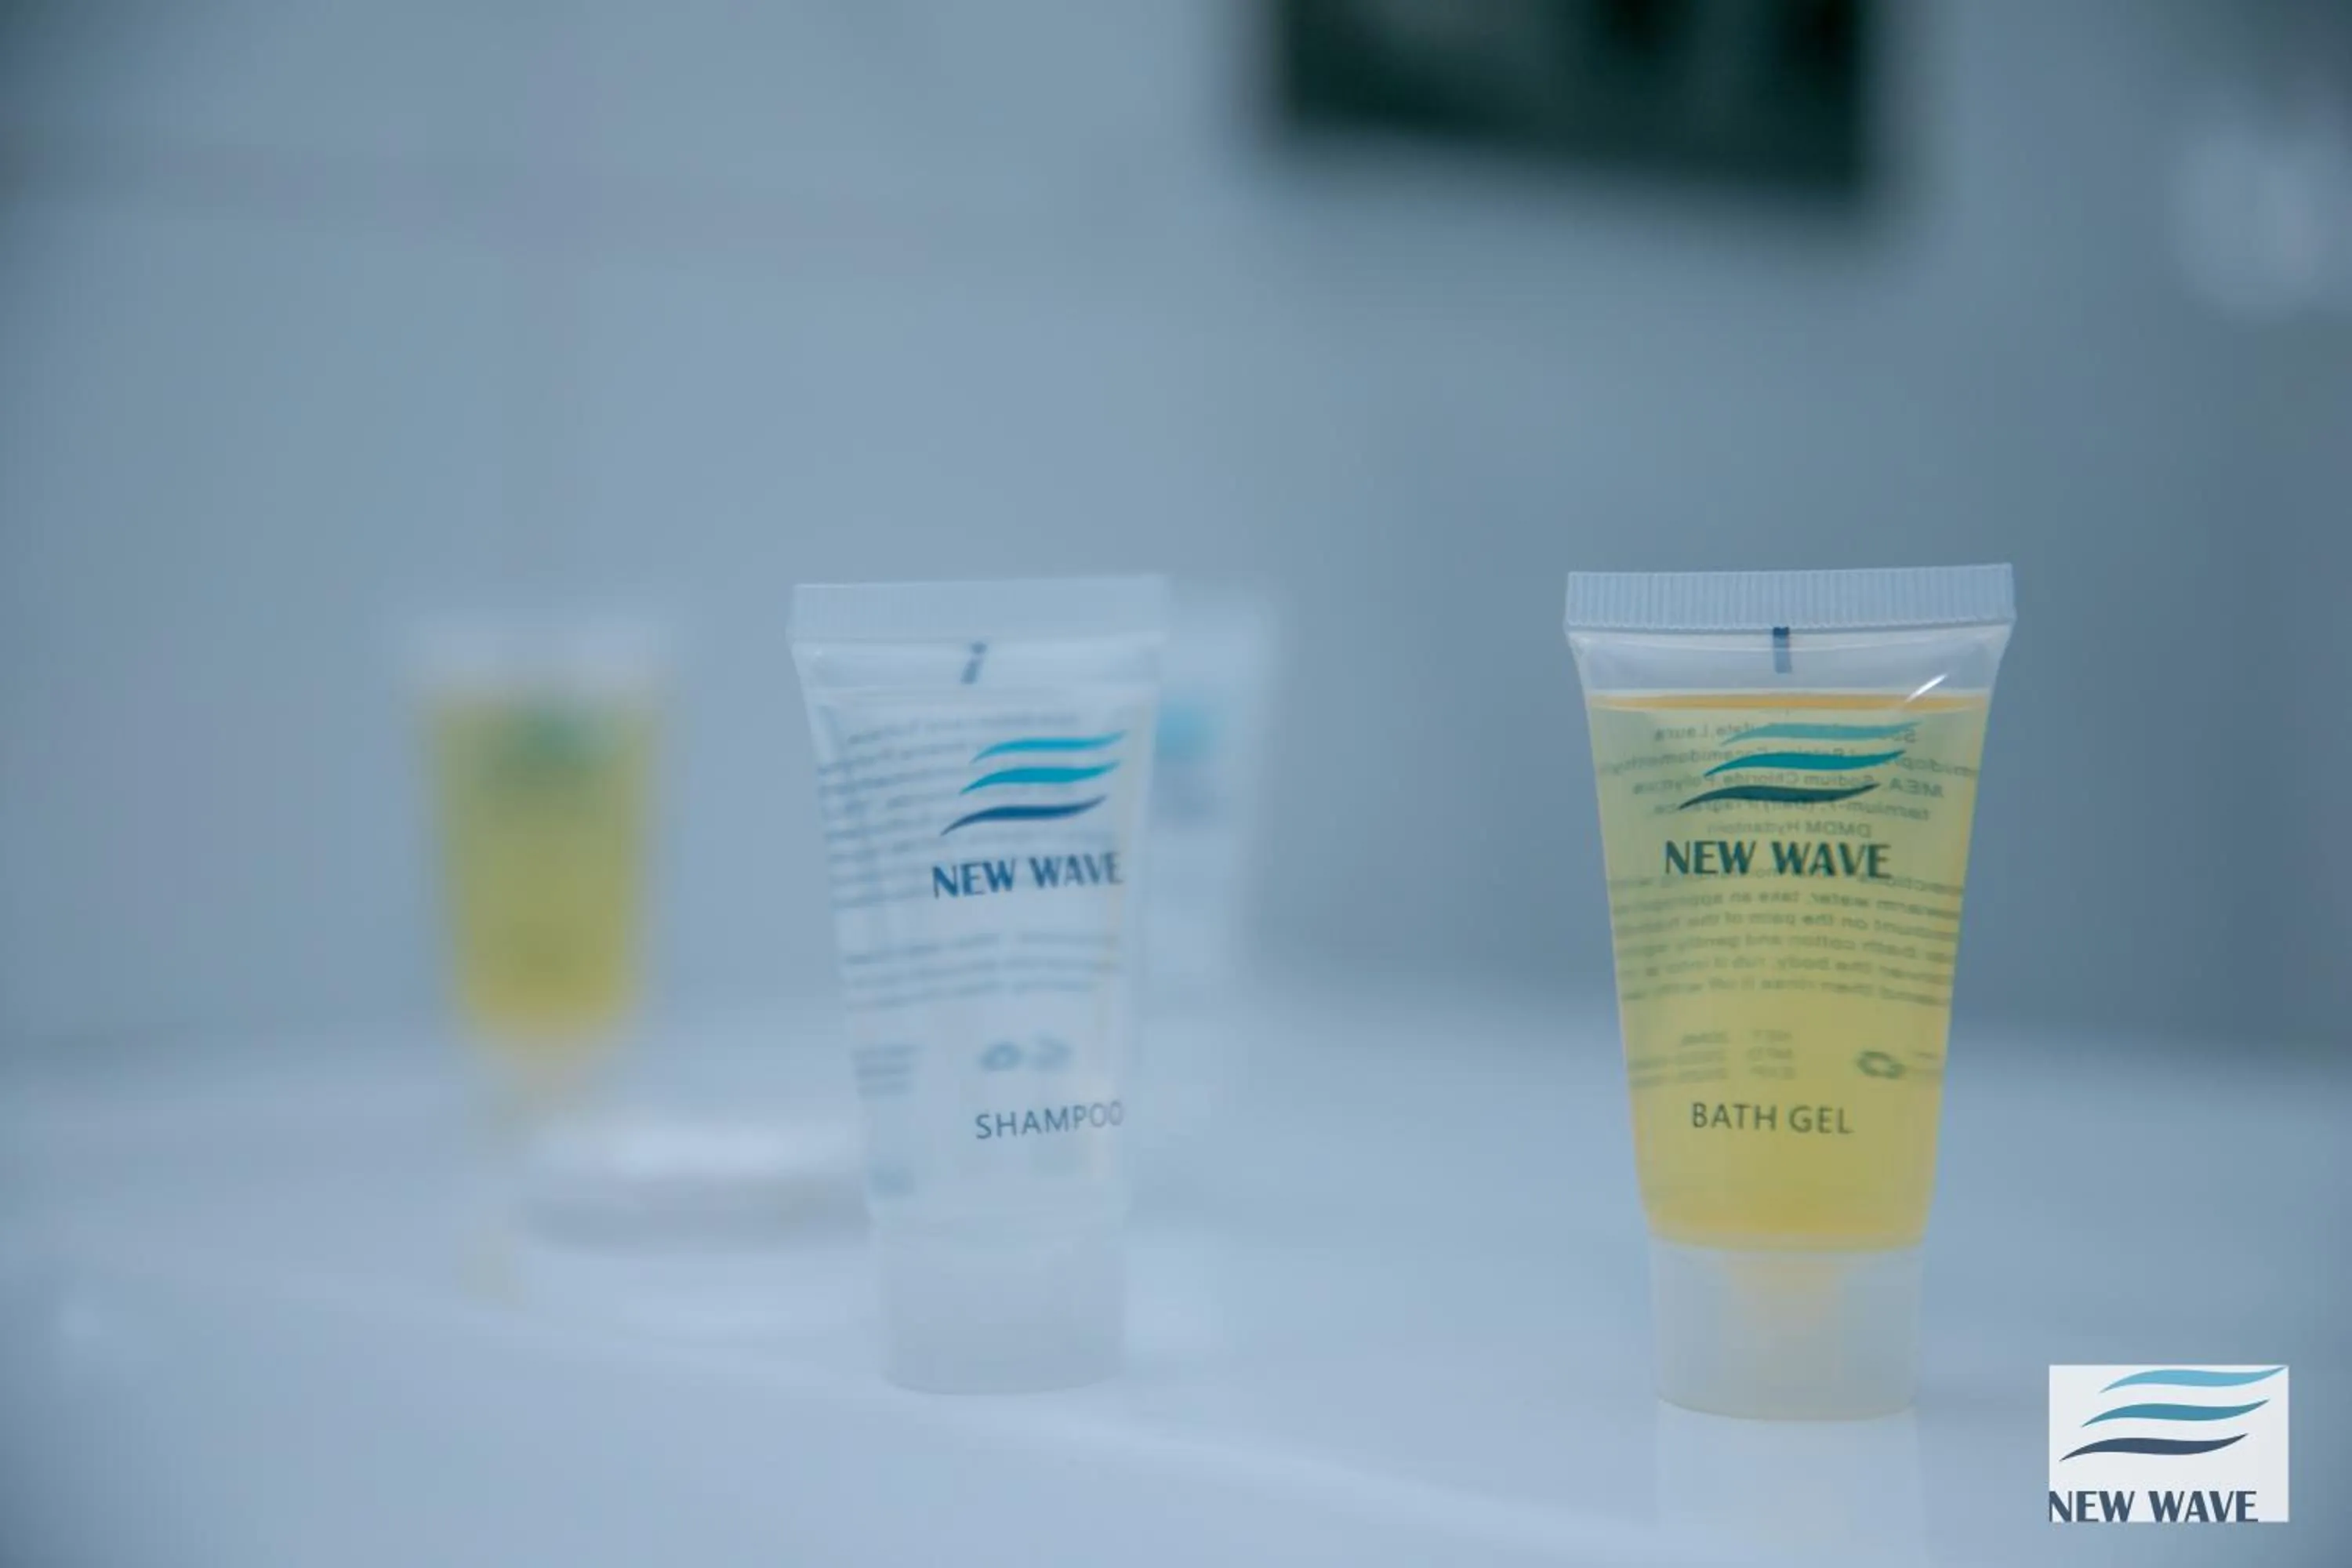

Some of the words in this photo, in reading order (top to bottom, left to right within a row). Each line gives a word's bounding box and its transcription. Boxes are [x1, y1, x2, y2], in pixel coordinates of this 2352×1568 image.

[932, 858, 1018, 899] NEW
[1029, 851, 1124, 890] WAVE
[1664, 840, 1757, 876] NEW
[1770, 841, 1892, 880] WAVE
[975, 1098, 1125, 1140] SHAMPOO
[1691, 1102, 1778, 1131] BATH
[1788, 1105, 1856, 1134] GEL
